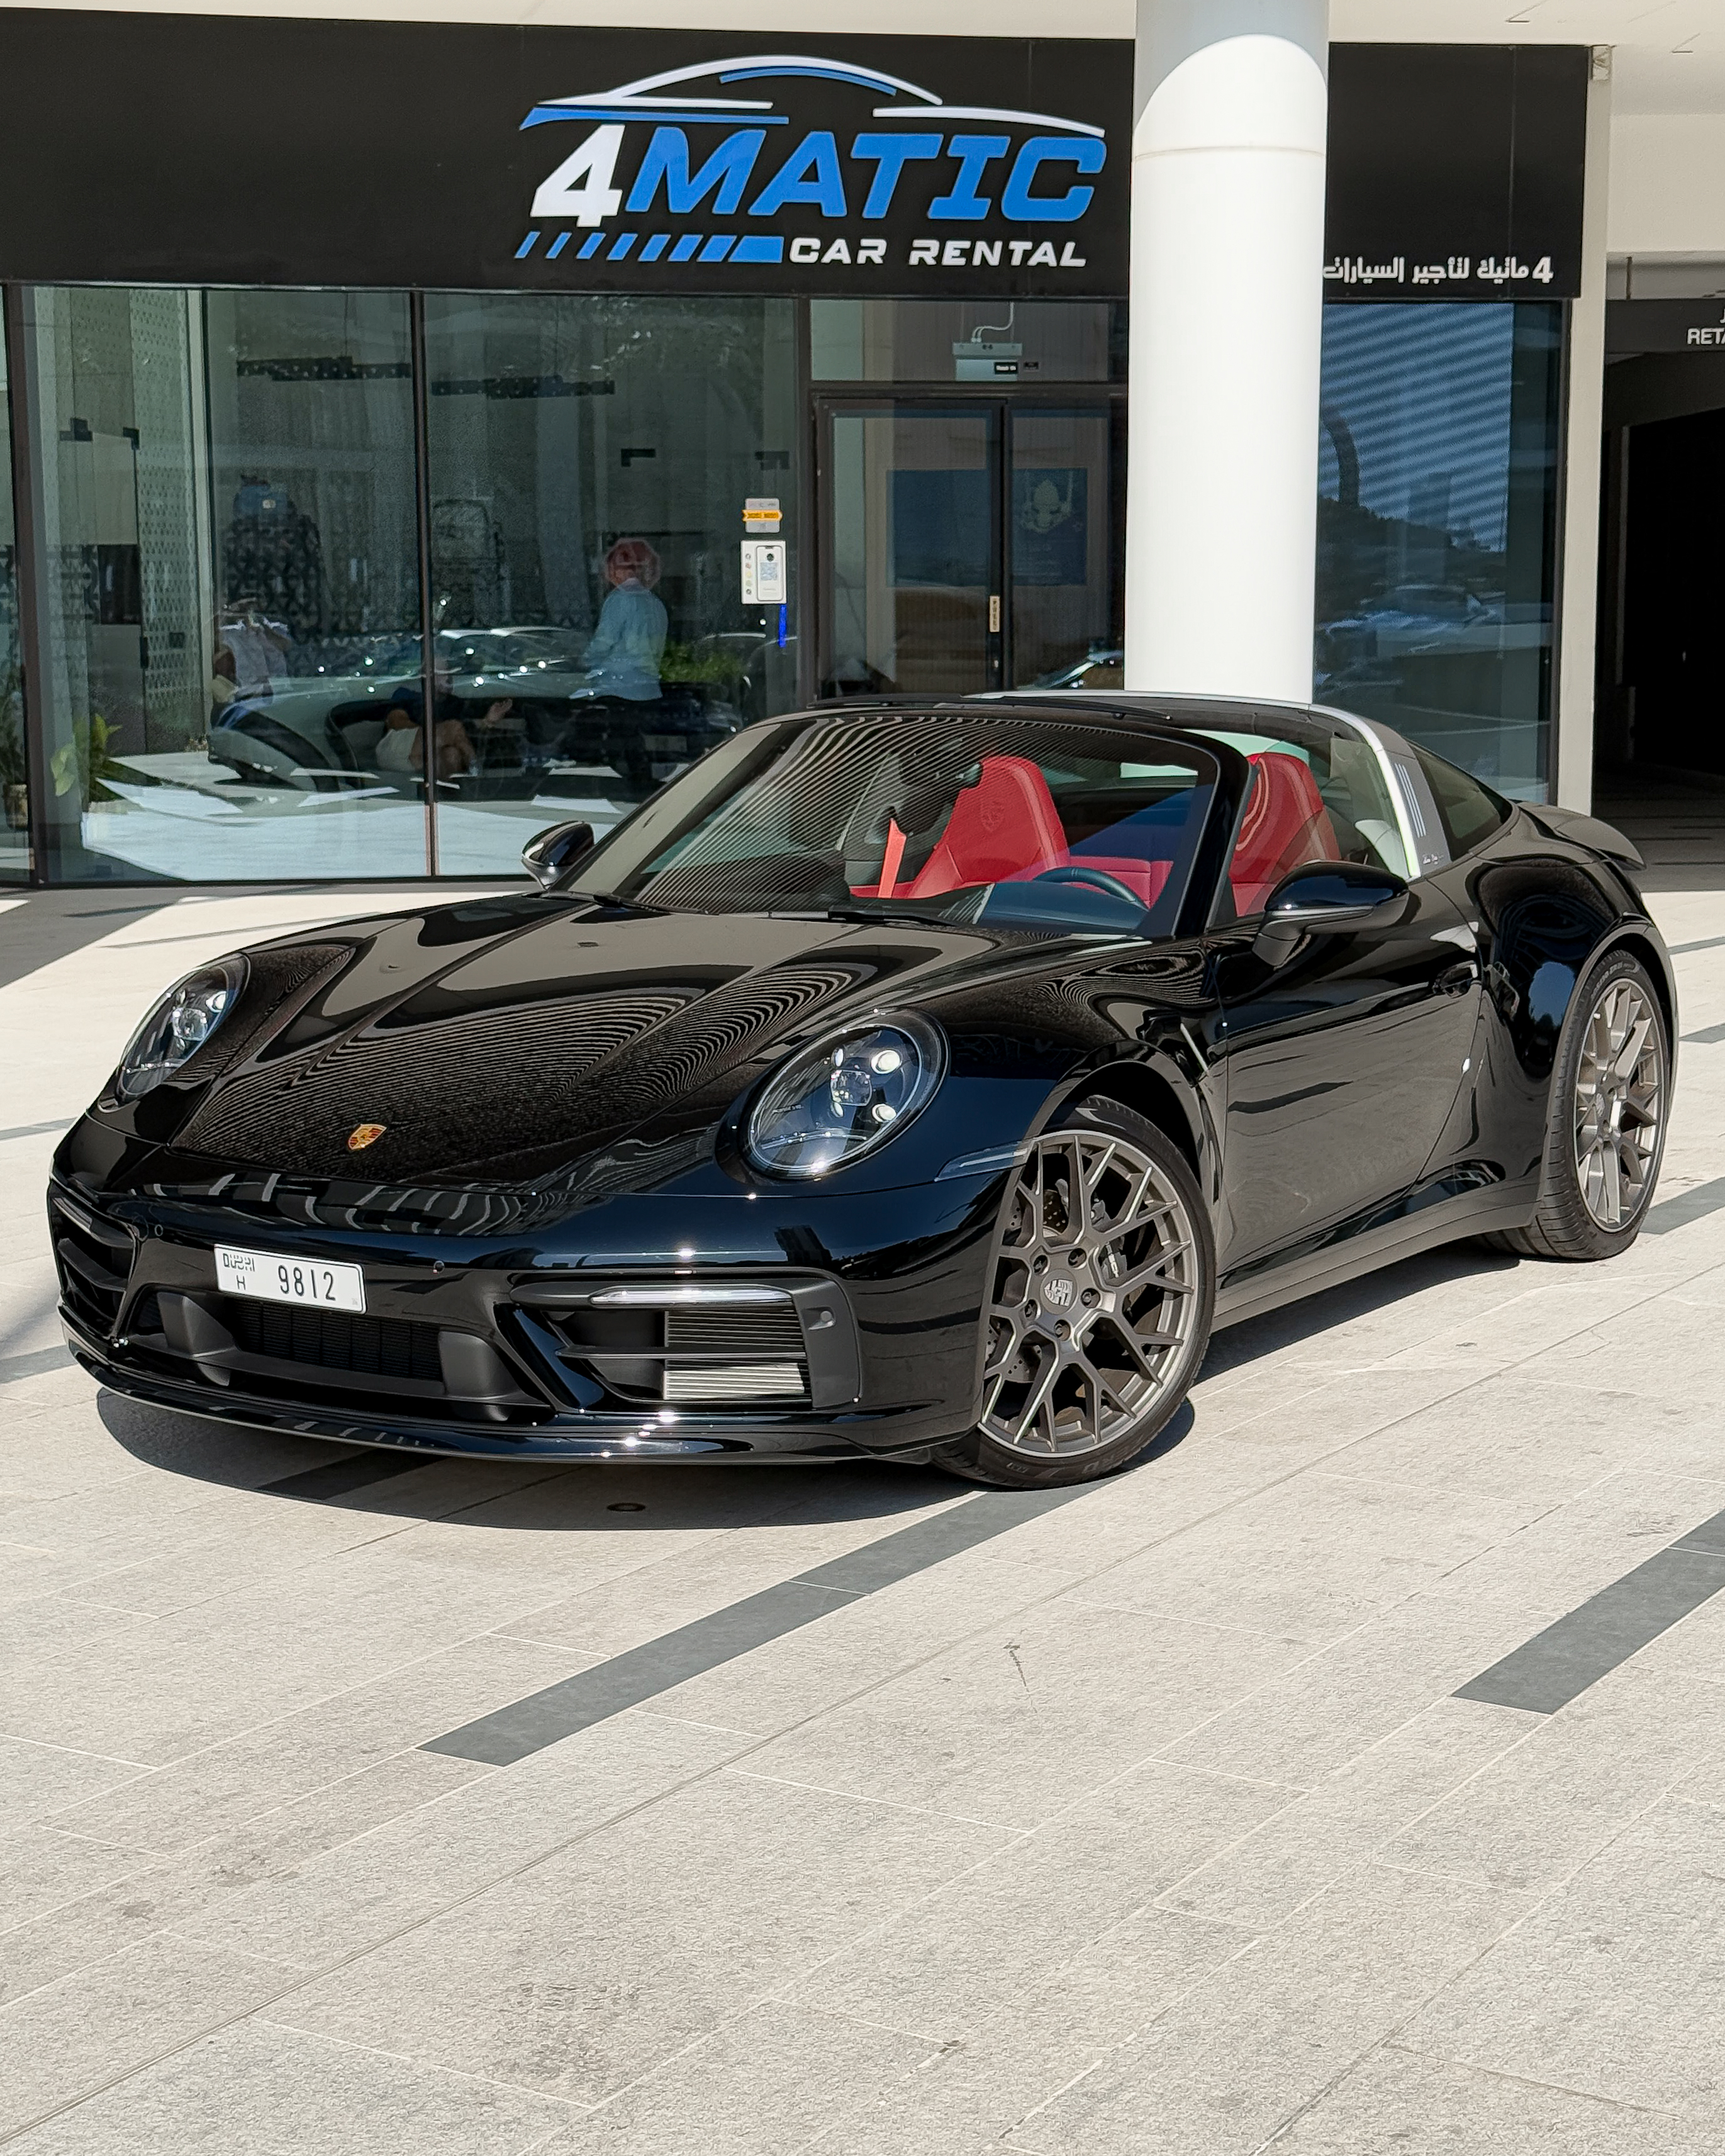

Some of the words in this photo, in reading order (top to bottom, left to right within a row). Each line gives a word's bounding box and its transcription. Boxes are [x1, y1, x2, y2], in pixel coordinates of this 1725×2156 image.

[530, 124, 1106, 227] 4MATIC
[789, 237, 888, 264] CAR
[910, 239, 1086, 267] RENTAL
[1322, 256, 1405, 284] السيارات
[1411, 256, 1470, 284] لتأجير
[236, 1275, 246, 1291] H
[278, 1265, 337, 1302] 9812
